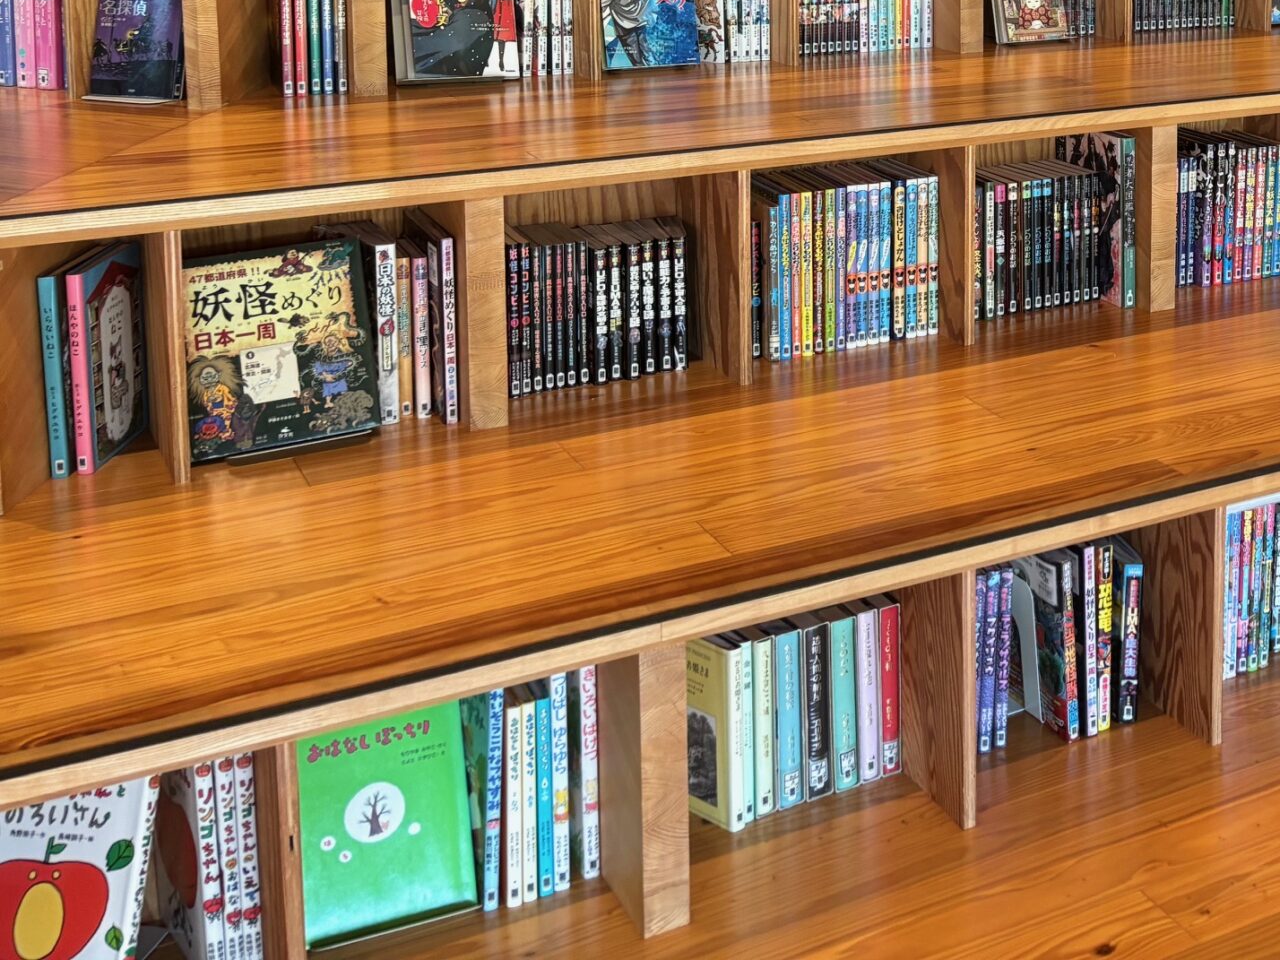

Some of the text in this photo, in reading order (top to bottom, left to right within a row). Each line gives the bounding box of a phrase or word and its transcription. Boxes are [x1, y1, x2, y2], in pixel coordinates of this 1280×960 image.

[102, 0, 148, 17] 名探偵
[189, 281, 343, 329] 妖怪めぐり
[377, 263, 395, 318] 日本の妖怪
[443, 278, 456, 332] 妖怪めぐり
[509, 248, 518, 318] 妖怪コンビニ
[521, 246, 531, 315] 妖怪コンビニ
[674, 257, 686, 316] UFOと宇宙人の謎
[44, 307, 56, 360] いらないねこ
[69, 304, 80, 357] ほんやのねこ
[193, 321, 277, 352] 日本一周
[1085, 586, 1095, 642] 妖怪めぐり
[1097, 582, 1113, 634] 恐竜
[1126, 606, 1138, 634] UMA
[999, 614, 1013, 690] ティラノサウルス
[306, 733, 370, 763] おはなし
[553, 727, 568, 776] ゆらゆら
[4, 802, 111, 829] のろいさん
[197, 788, 221, 884] リンゴちゃん
[220, 781, 240, 907] リンゴちゃんのおはな
